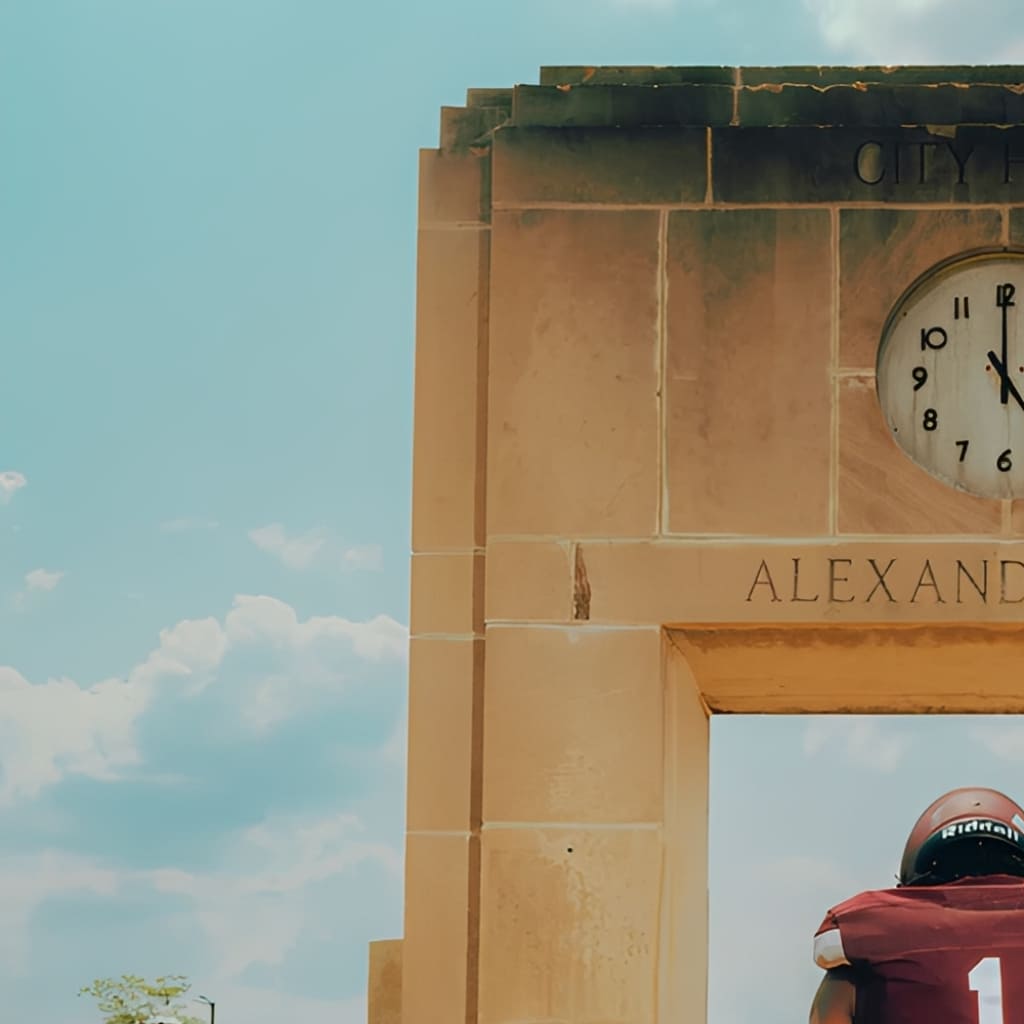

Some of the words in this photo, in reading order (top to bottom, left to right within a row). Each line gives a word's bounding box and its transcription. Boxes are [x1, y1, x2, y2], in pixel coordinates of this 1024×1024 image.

[853, 140, 974, 185] CITY
[996, 283, 1015, 308] 12
[954, 297, 970, 320] 11
[920, 327, 948, 351] 10
[912, 366, 928, 391] 9
[923, 408, 938, 431] 8
[955, 440, 969, 462] 7
[997, 449, 1013, 472] 6
